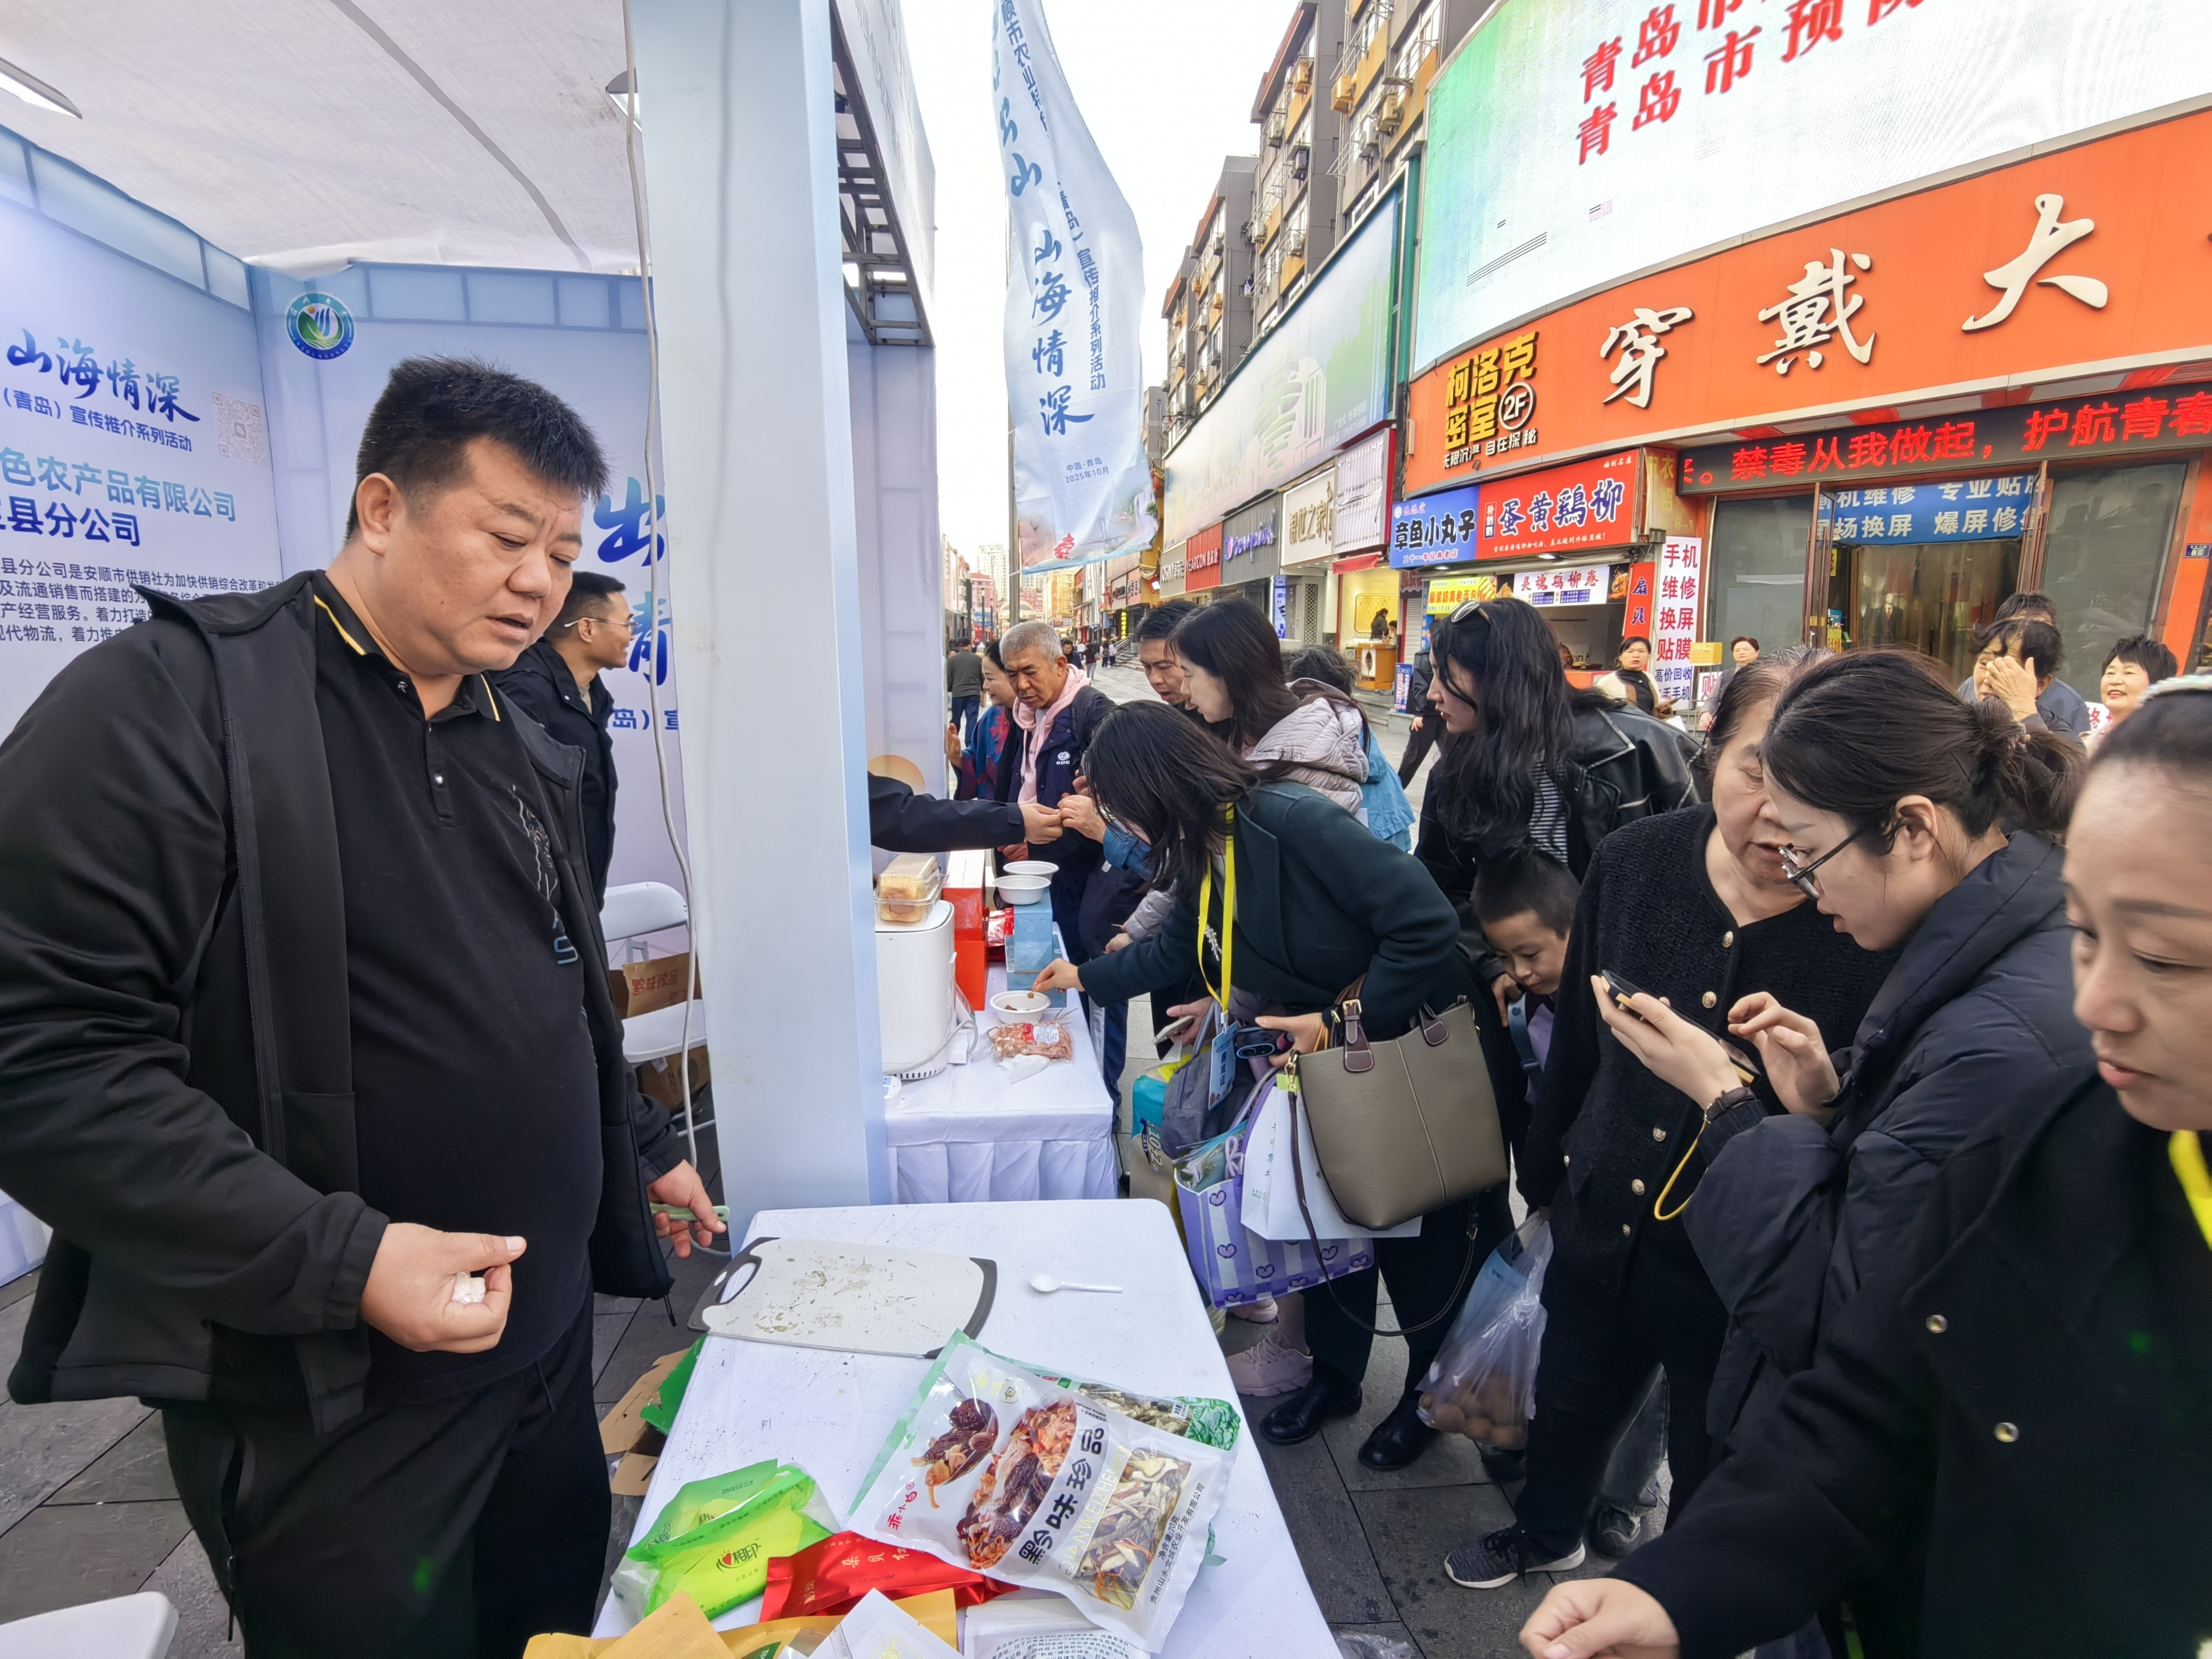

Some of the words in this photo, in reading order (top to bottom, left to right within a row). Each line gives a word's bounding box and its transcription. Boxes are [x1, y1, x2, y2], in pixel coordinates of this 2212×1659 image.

[1032, 229, 1095, 436] 山海情深
[7, 328, 202, 423] 山海情深
[1446, 331, 1537, 408] 柯洛克
[3, 388, 193, 452] （青岛）宣传推介系列活动
[1503, 391, 1528, 421] 2F
[1445, 393, 1498, 450] 密室
[1485, 428, 1537, 456] 自在探秘
[0, 447, 237, 522] 色农产品有限公司
[1065, 466, 1109, 483] 2025年10月
[1394, 509, 1476, 551] 章鱼小丸子
[1663, 543, 1699, 569] 手机
[1521, 569, 1599, 591] 灵魂鸡柳卷
[1662, 575, 1696, 600] 维修
[0, 601, 153, 623] 产经营服务。着力打造
[1631, 577, 1648, 625] 扇贝
[1660, 607, 1694, 631] 换屏
[1656, 637, 1692, 662] 贴膜
[1654, 667, 1692, 683] 高价回收
[1658, 686, 1690, 701] 手手机
[1018, 1427, 1105, 1567] 黔味珍品
[1150, 1482, 1205, 1604] 贵州山水文城农业开发有限公司
